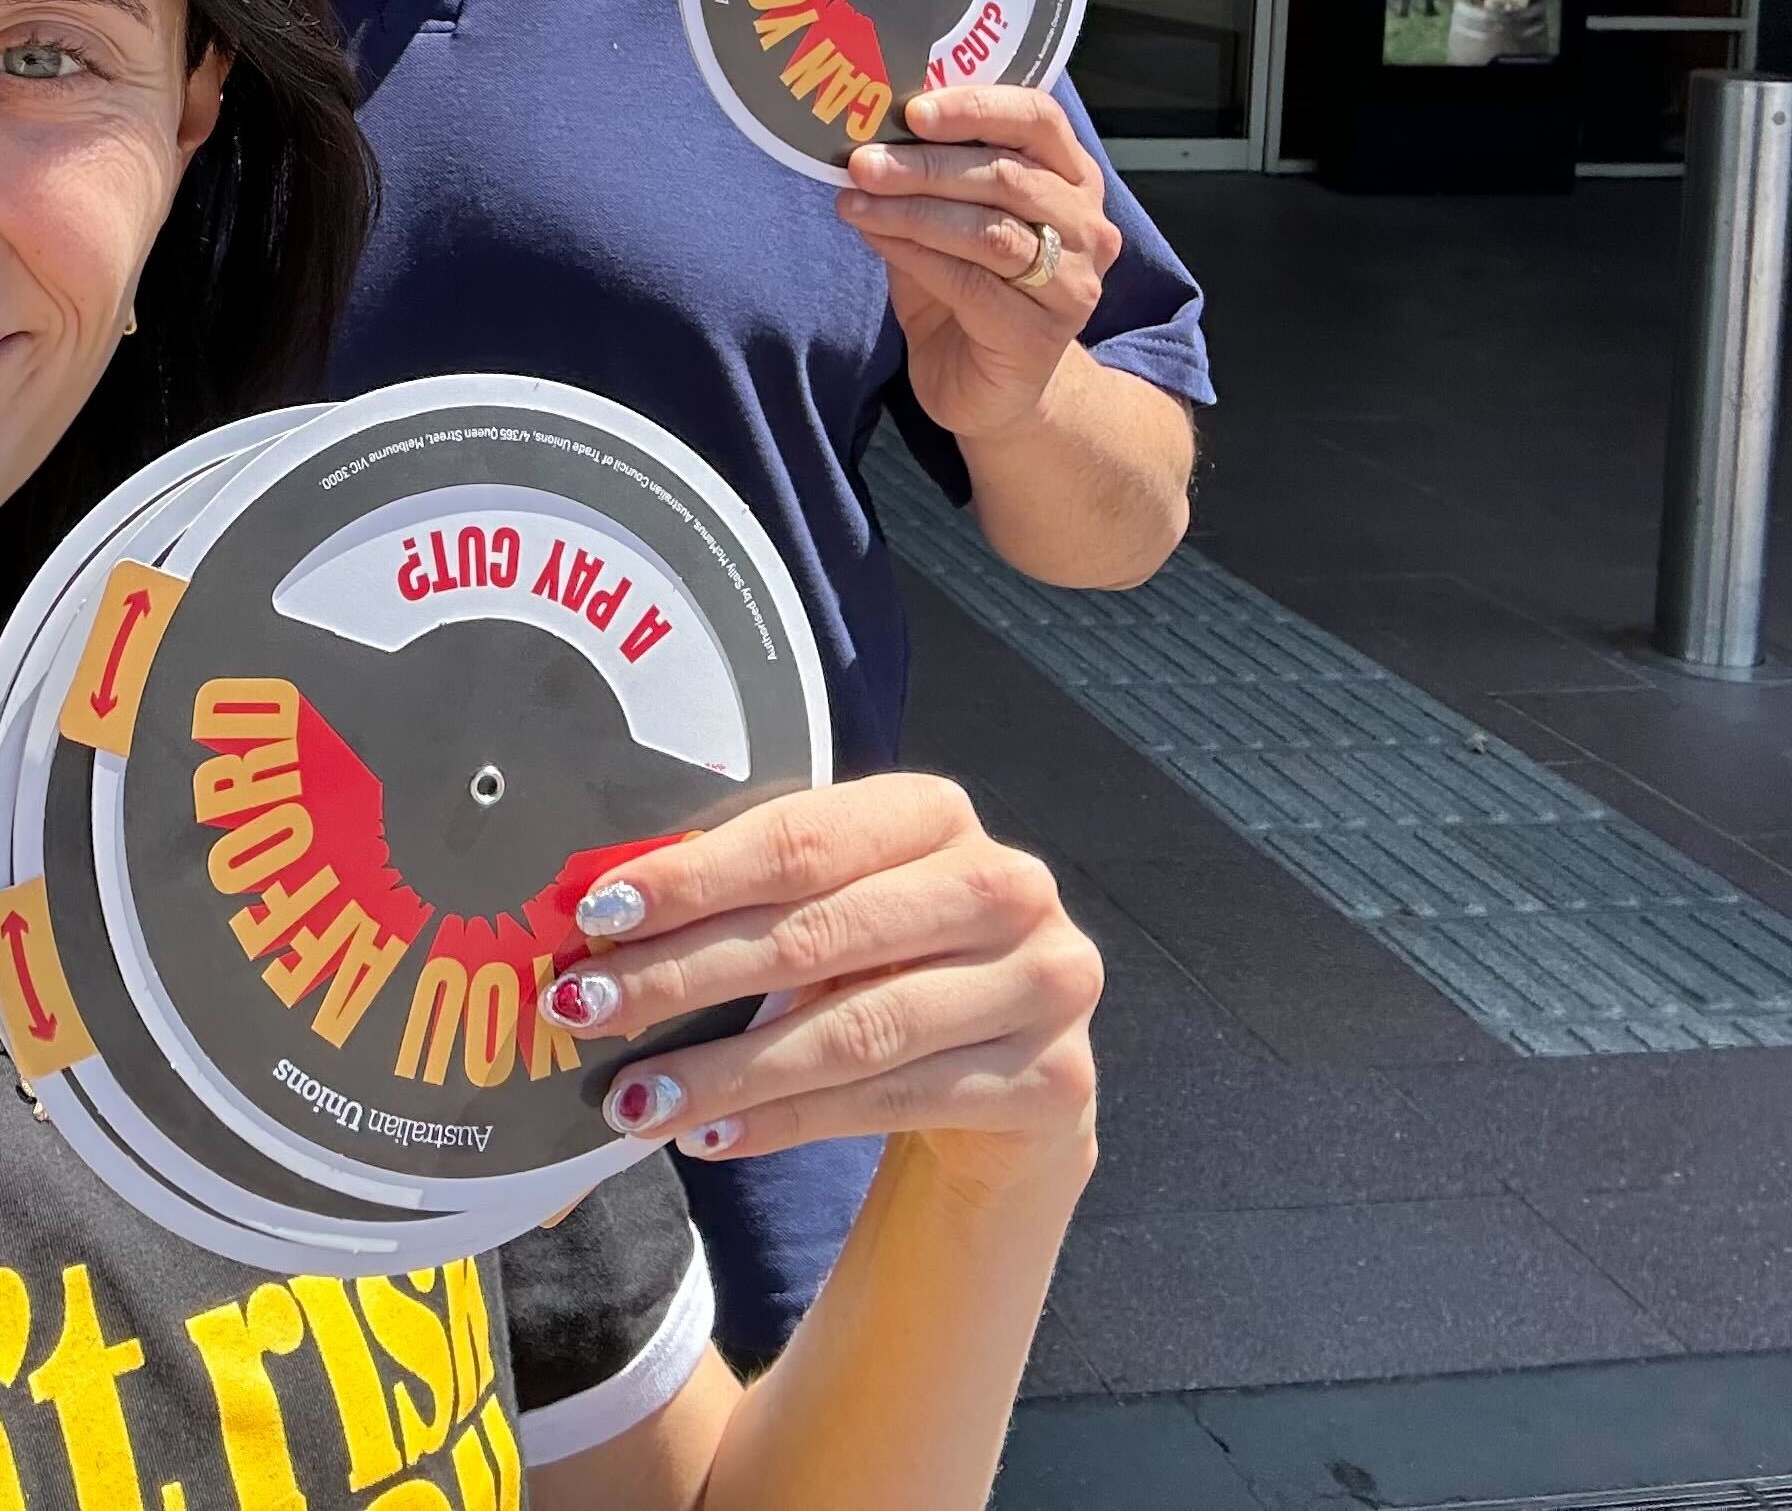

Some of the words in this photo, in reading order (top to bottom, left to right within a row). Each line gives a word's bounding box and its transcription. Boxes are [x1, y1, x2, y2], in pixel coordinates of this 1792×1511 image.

[951, 1, 1009, 77] CUT?
[779, 37, 893, 142] CAN
[425, 429, 463, 445] Street,
[464, 427, 498, 440] Queen
[499, 427, 531, 443] 4/365
[532, 430, 571, 452] Unions,
[369, 436, 425, 463] Melbourne
[572, 441, 601, 463] Trade
[601, 453, 614, 465] of
[318, 466, 352, 491] 3000.
[349, 456, 370, 475] VIC
[613, 459, 650, 488] Council
[649, 480, 695, 524] Australian
[692, 517, 729, 568] McManus,
[397, 525, 521, 601] CUT?
[726, 562, 746, 591] Sally
[530, 539, 633, 632] PAY
[740, 587, 753, 604] by
[619, 603, 673, 664] A
[746, 601, 778, 661] Authorised
[191, 677, 410, 1049] AFFORD
[272, 1058, 364, 1131] Unions
[368, 1108, 494, 1152] Australian
